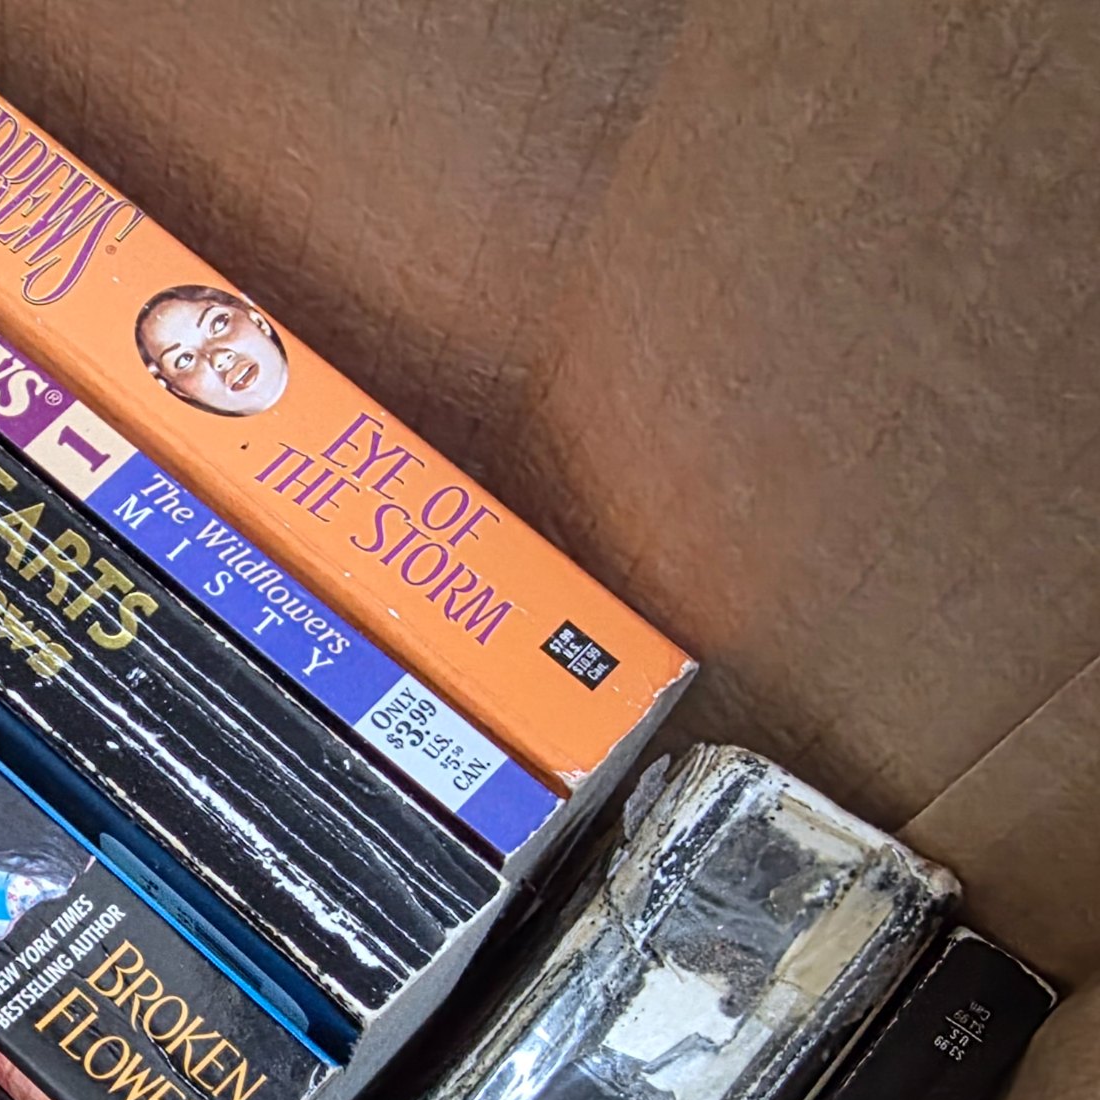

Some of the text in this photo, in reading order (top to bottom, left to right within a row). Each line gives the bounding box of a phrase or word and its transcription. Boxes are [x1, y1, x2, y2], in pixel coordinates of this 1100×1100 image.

[57, 425, 111, 473] 1
[320, 412, 500, 547] EYE OF
[140, 473, 351, 656] The Wildflowers
[254, 442, 513, 646] THE STORM
[370, 686, 418, 730] ONLY
[386, 698, 437, 750] $3.99
[422, 733, 454, 761] U.S.
[452, 757, 492, 792] CAN.
[15, 930, 59, 970] YORK
[51, 893, 95, 939] TIMES
[68, 903, 126, 961] AUTHOR
[934, 1035, 965, 1060] $3.99
